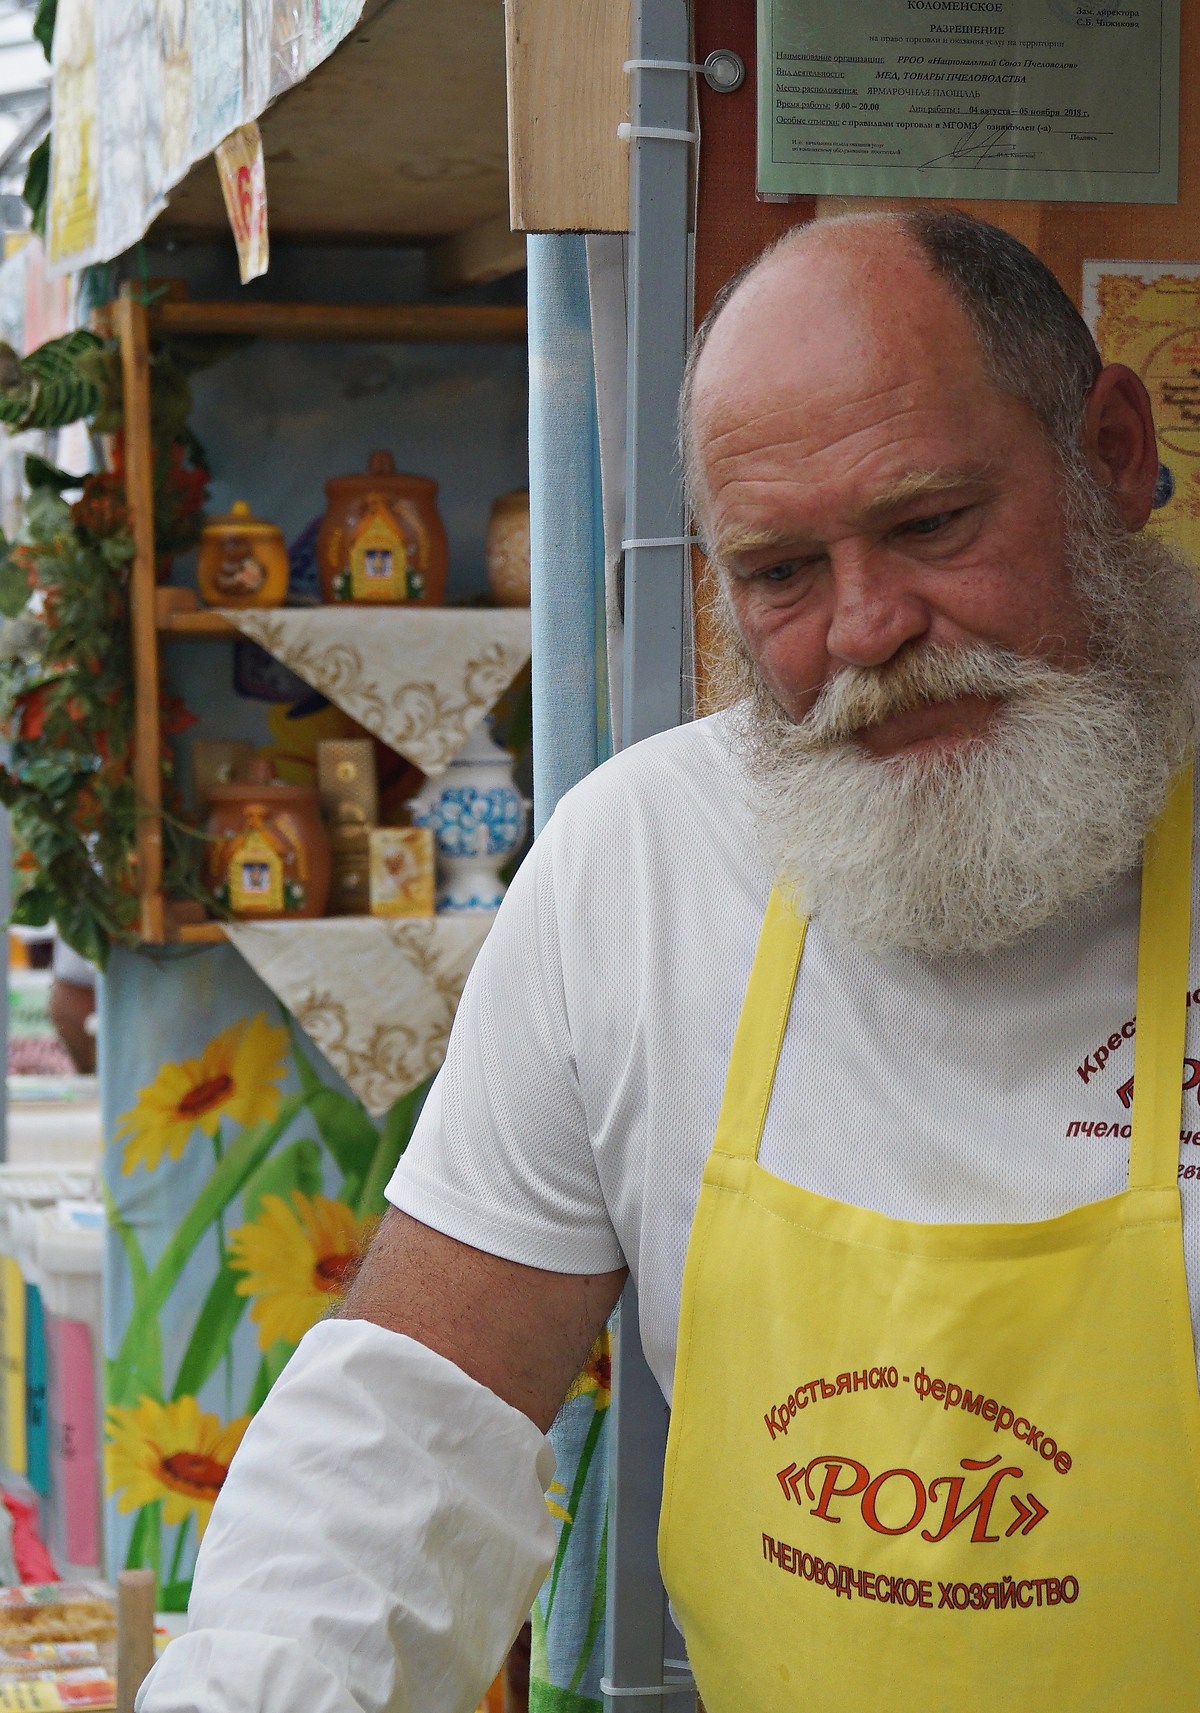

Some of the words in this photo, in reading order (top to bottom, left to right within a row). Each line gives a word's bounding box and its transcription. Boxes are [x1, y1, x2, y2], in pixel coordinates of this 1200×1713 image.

[907, 0, 1003, 13] КОЛОМЕНСКОЕ
[1076, 6, 1095, 16] Зам.
[1096, 8, 1140, 19] директора
[929, 24, 1005, 35] РАЗРЕШЕНИЕ
[897, 55, 925, 64] РРОО
[903, 71, 945, 82] ТОВАРЫ
[945, 73, 1027, 84] ПЧЕЛОВОДСТВА
[866, 86, 931, 97] ЯРМАРОЧНАЯ
[932, 88, 981, 99] ПЛОЩАДЬ
[834, 102, 850, 110] 9.00
[859, 102, 880, 112] 20.00
[969, 105, 978, 114] 04
[980, 106, 1011, 117] августа
[1019, 107, 1029, 116] 05
[1030, 107, 1061, 118] ноября
[1064, 108, 1082, 117] 2018
[942, 121, 979, 131] МГОМЗ
[763, 1366, 899, 1441] Крестьянско
[914, 1366, 1073, 1475] фермерское
[775, 1455, 1050, 1544] «РОЙ»
[761, 1532, 933, 1609] ПЧЕЛОВОДЧЕСКОЕ
[937, 1575, 1081, 1611] ХОЗЯЙСТВО
